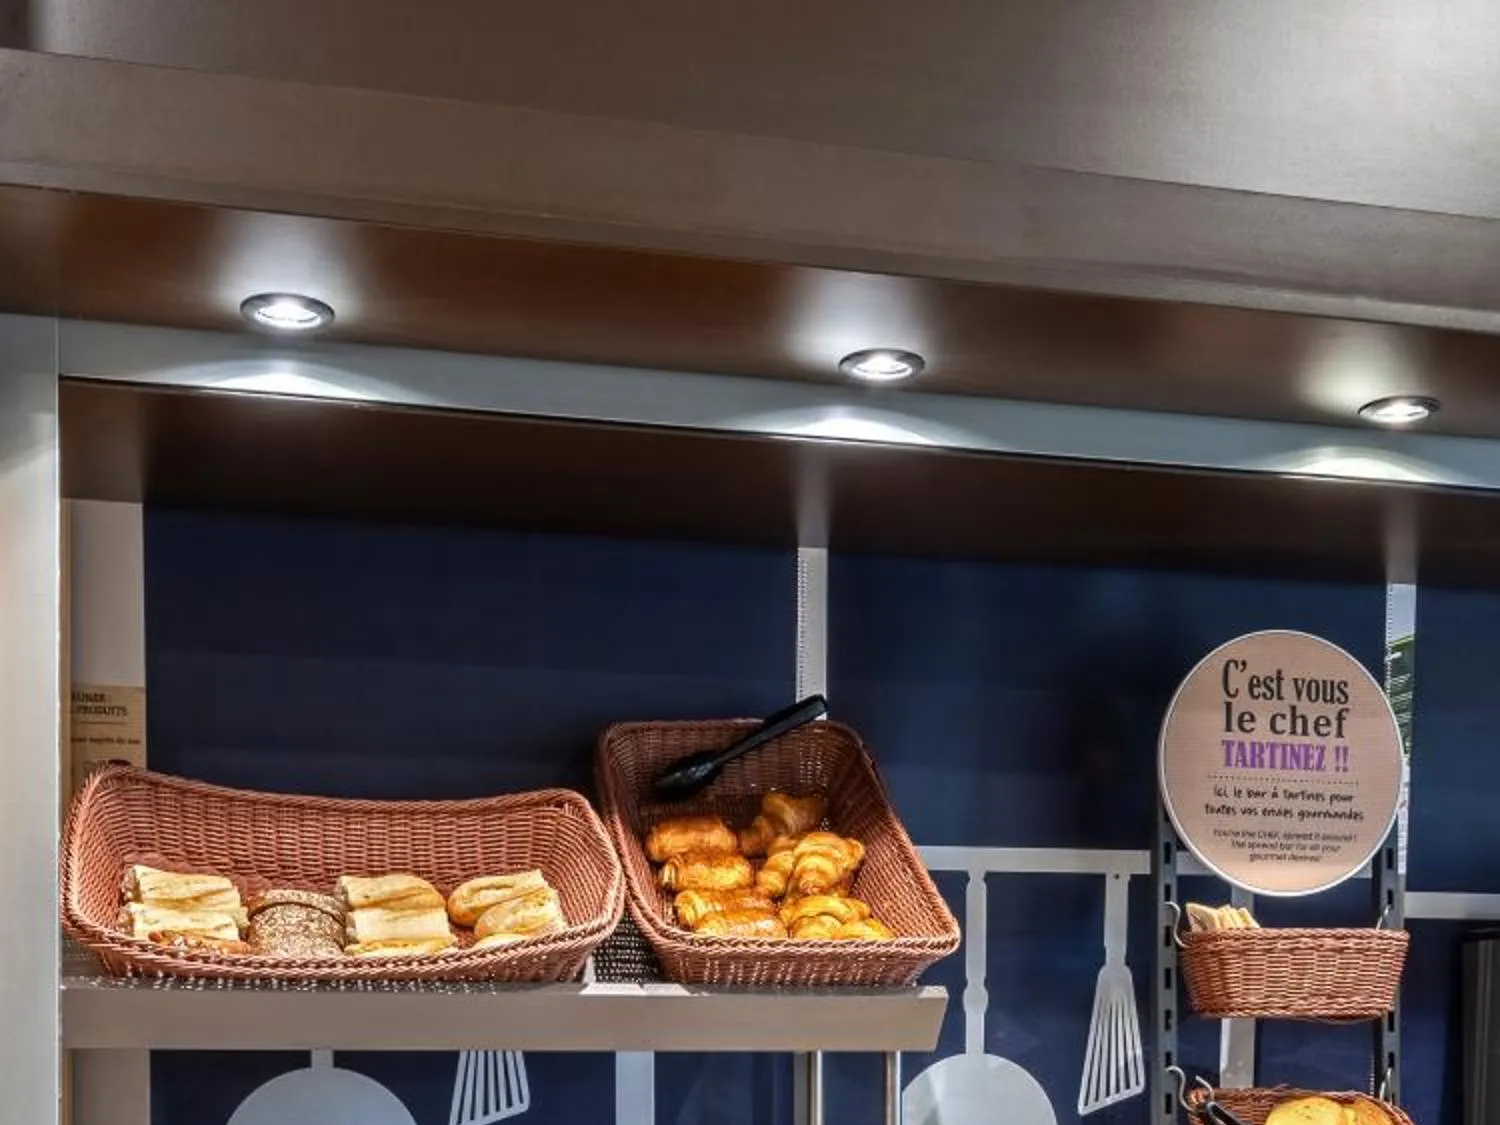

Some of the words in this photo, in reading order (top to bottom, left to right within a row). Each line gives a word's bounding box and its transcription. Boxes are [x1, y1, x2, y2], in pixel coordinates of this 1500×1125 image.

[1222, 659, 1285, 701] C'est
[1292, 677, 1349, 705] vous
[1224, 701, 1256, 734] le
[1269, 704, 1350, 738] chef
[1222, 739, 1326, 771] TARTINEZ
[1334, 745, 1349, 773] !!
[1240, 806, 1259, 817] vos
